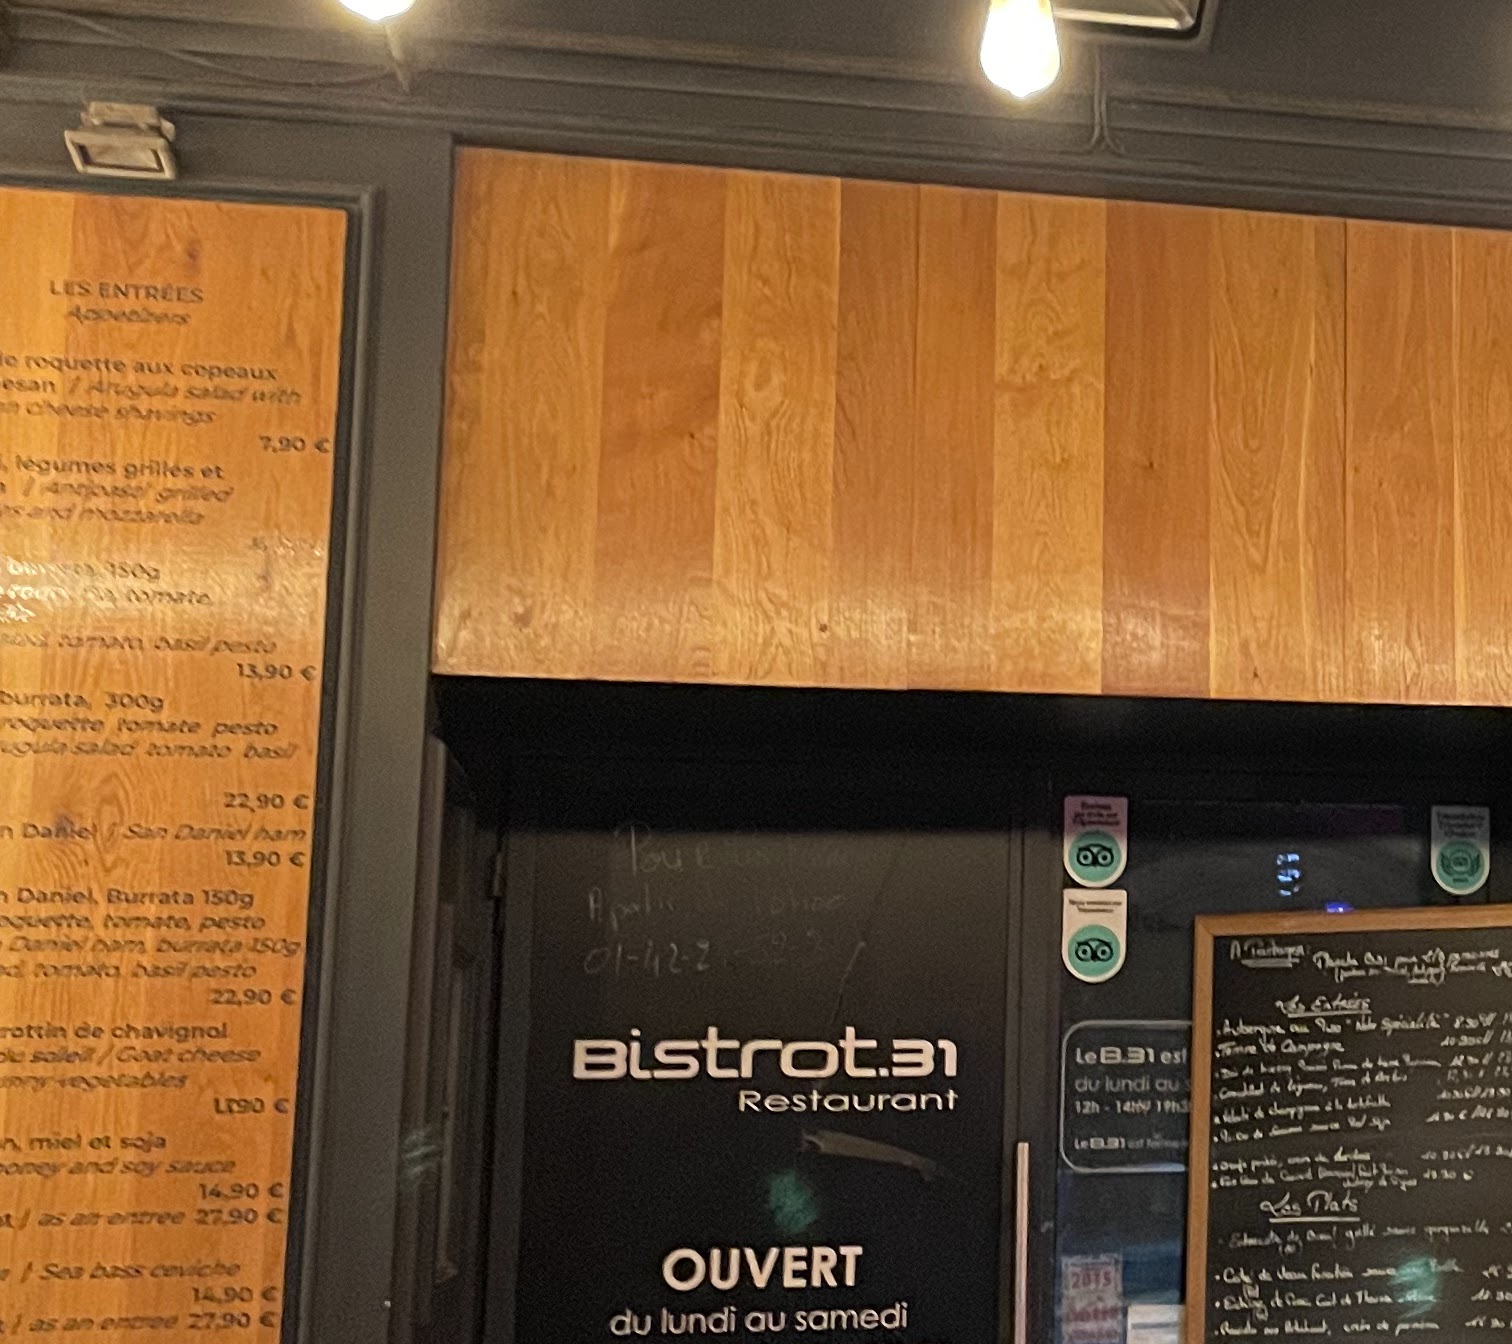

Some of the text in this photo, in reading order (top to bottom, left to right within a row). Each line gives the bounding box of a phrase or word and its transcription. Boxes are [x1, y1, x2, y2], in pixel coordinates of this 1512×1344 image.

[51, 280, 91, 296] LES
[573, 1026, 957, 1080] Bistrot.31
[1075, 1047, 1097, 1065] Le
[1075, 1075, 1179, 1092] du lundi au
[738, 1088, 958, 1113] Restaurant
[1075, 1100, 1100, 1114] 12h
[662, 1245, 863, 1291] OUVERT
[609, 1302, 908, 1336] du lundi au samedi
